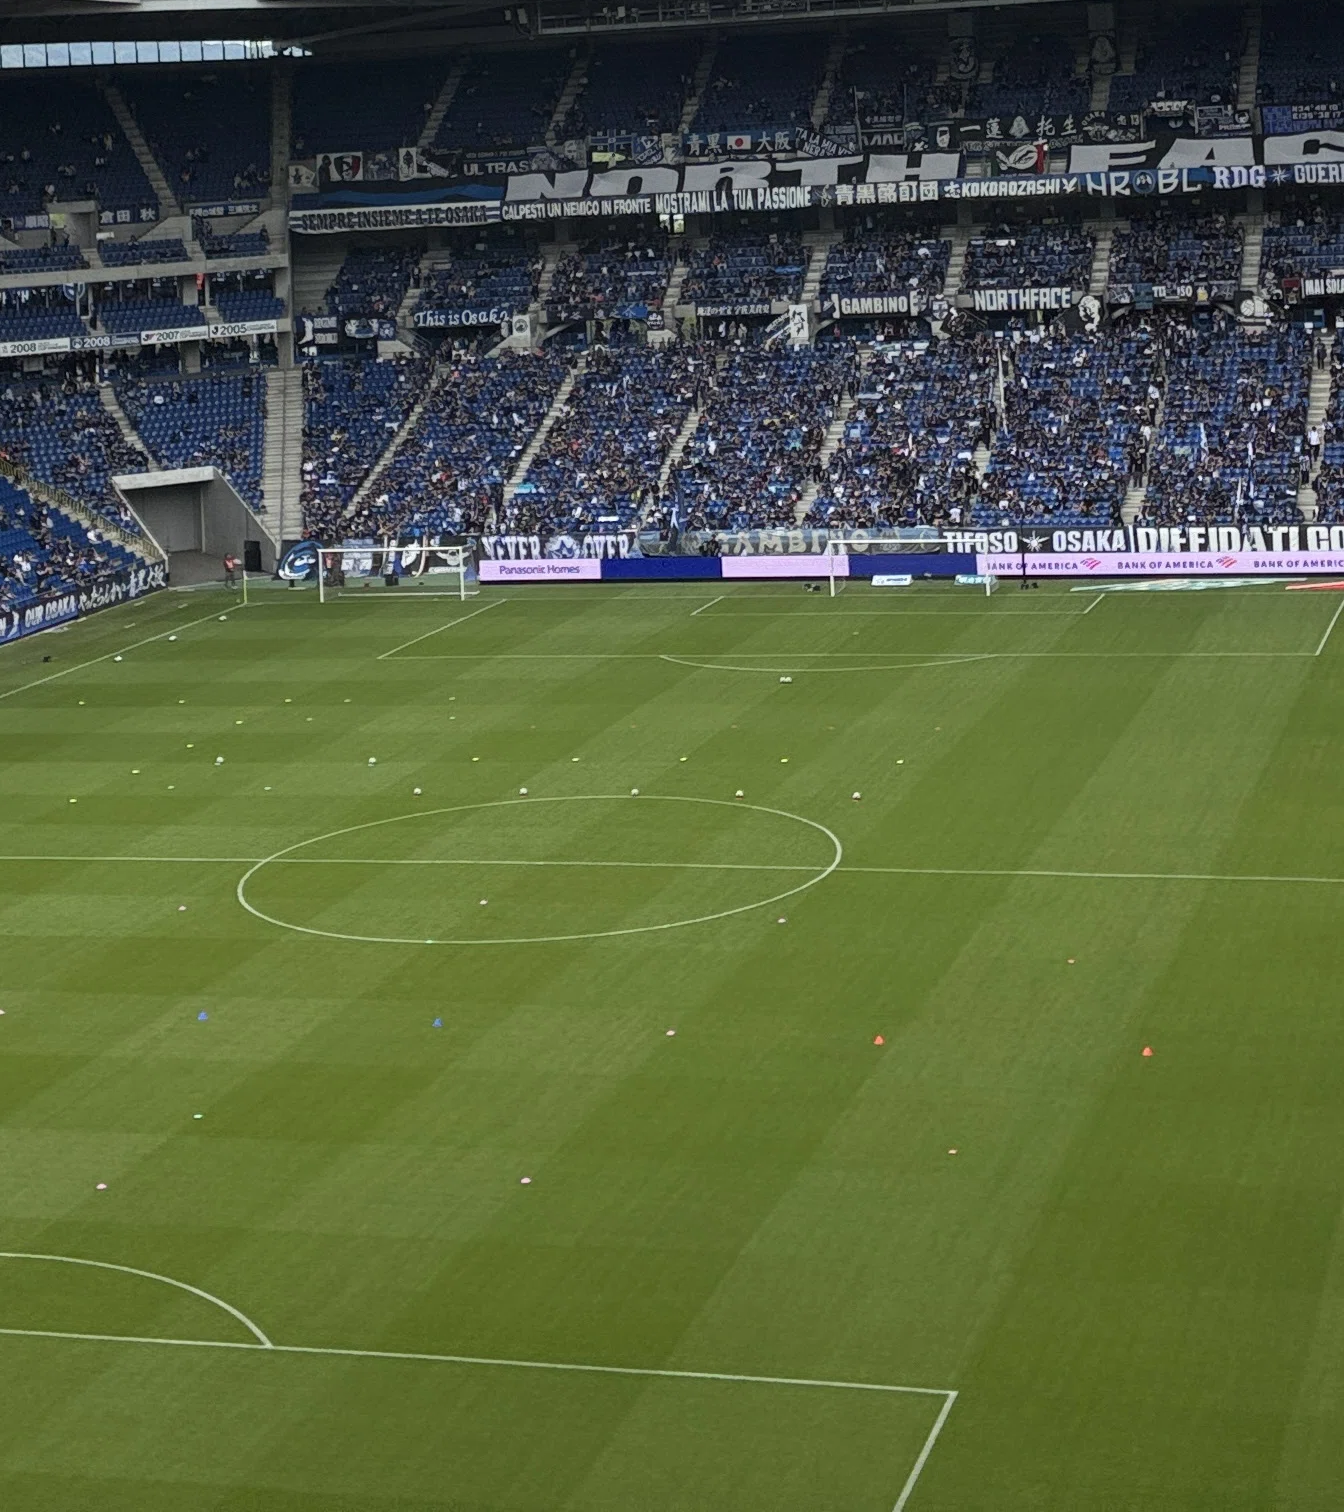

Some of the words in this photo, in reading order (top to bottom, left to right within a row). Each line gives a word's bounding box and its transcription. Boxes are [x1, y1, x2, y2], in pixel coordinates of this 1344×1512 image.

[687, 132, 723, 155] 青黒
[757, 129, 792, 152] 大阪
[463, 160, 529, 176] ULTRAS
[1212, 165, 1266, 189] RDG
[502, 202, 546, 221] CALPESTI
[547, 201, 563, 217] UN
[602, 199, 613, 215] IN
[615, 197, 652, 214] FRONTE
[655, 192, 707, 215] MOSTRAMI
[713, 191, 729, 212] LA
[733, 189, 753, 211] TUA
[757, 185, 812, 210] PASSIONE
[1305, 278, 1324, 296] MAI
[841, 296, 908, 315] GAMBINO
[973, 287, 1072, 311] NORTHFACE
[414, 311, 446, 327] This
[448, 310, 460, 326] is
[461, 307, 513, 325] Osaka
[156, 330, 180, 342] 2007
[220, 323, 247, 335] 2005
[10, 342, 37, 354] 2008
[943, 530, 1019, 554] TIFOSO
[1052, 529, 1128, 553] OSAKA
[1136, 525, 1301, 554] DIFFIDATI
[499, 563, 545, 575] Panasonic
[547, 563, 581, 575] Homes
[1031, 561, 1079, 570] AMERICA
[1117, 561, 1147, 570] BANK
[1149, 561, 1163, 570] OF
[1164, 560, 1214, 570] AMERICA
[1253, 559, 1284, 569] BANK
[1286, 559, 1301, 569] OF
[24, 606, 44, 628] OUR
[45, 594, 77, 621] OSAKA
